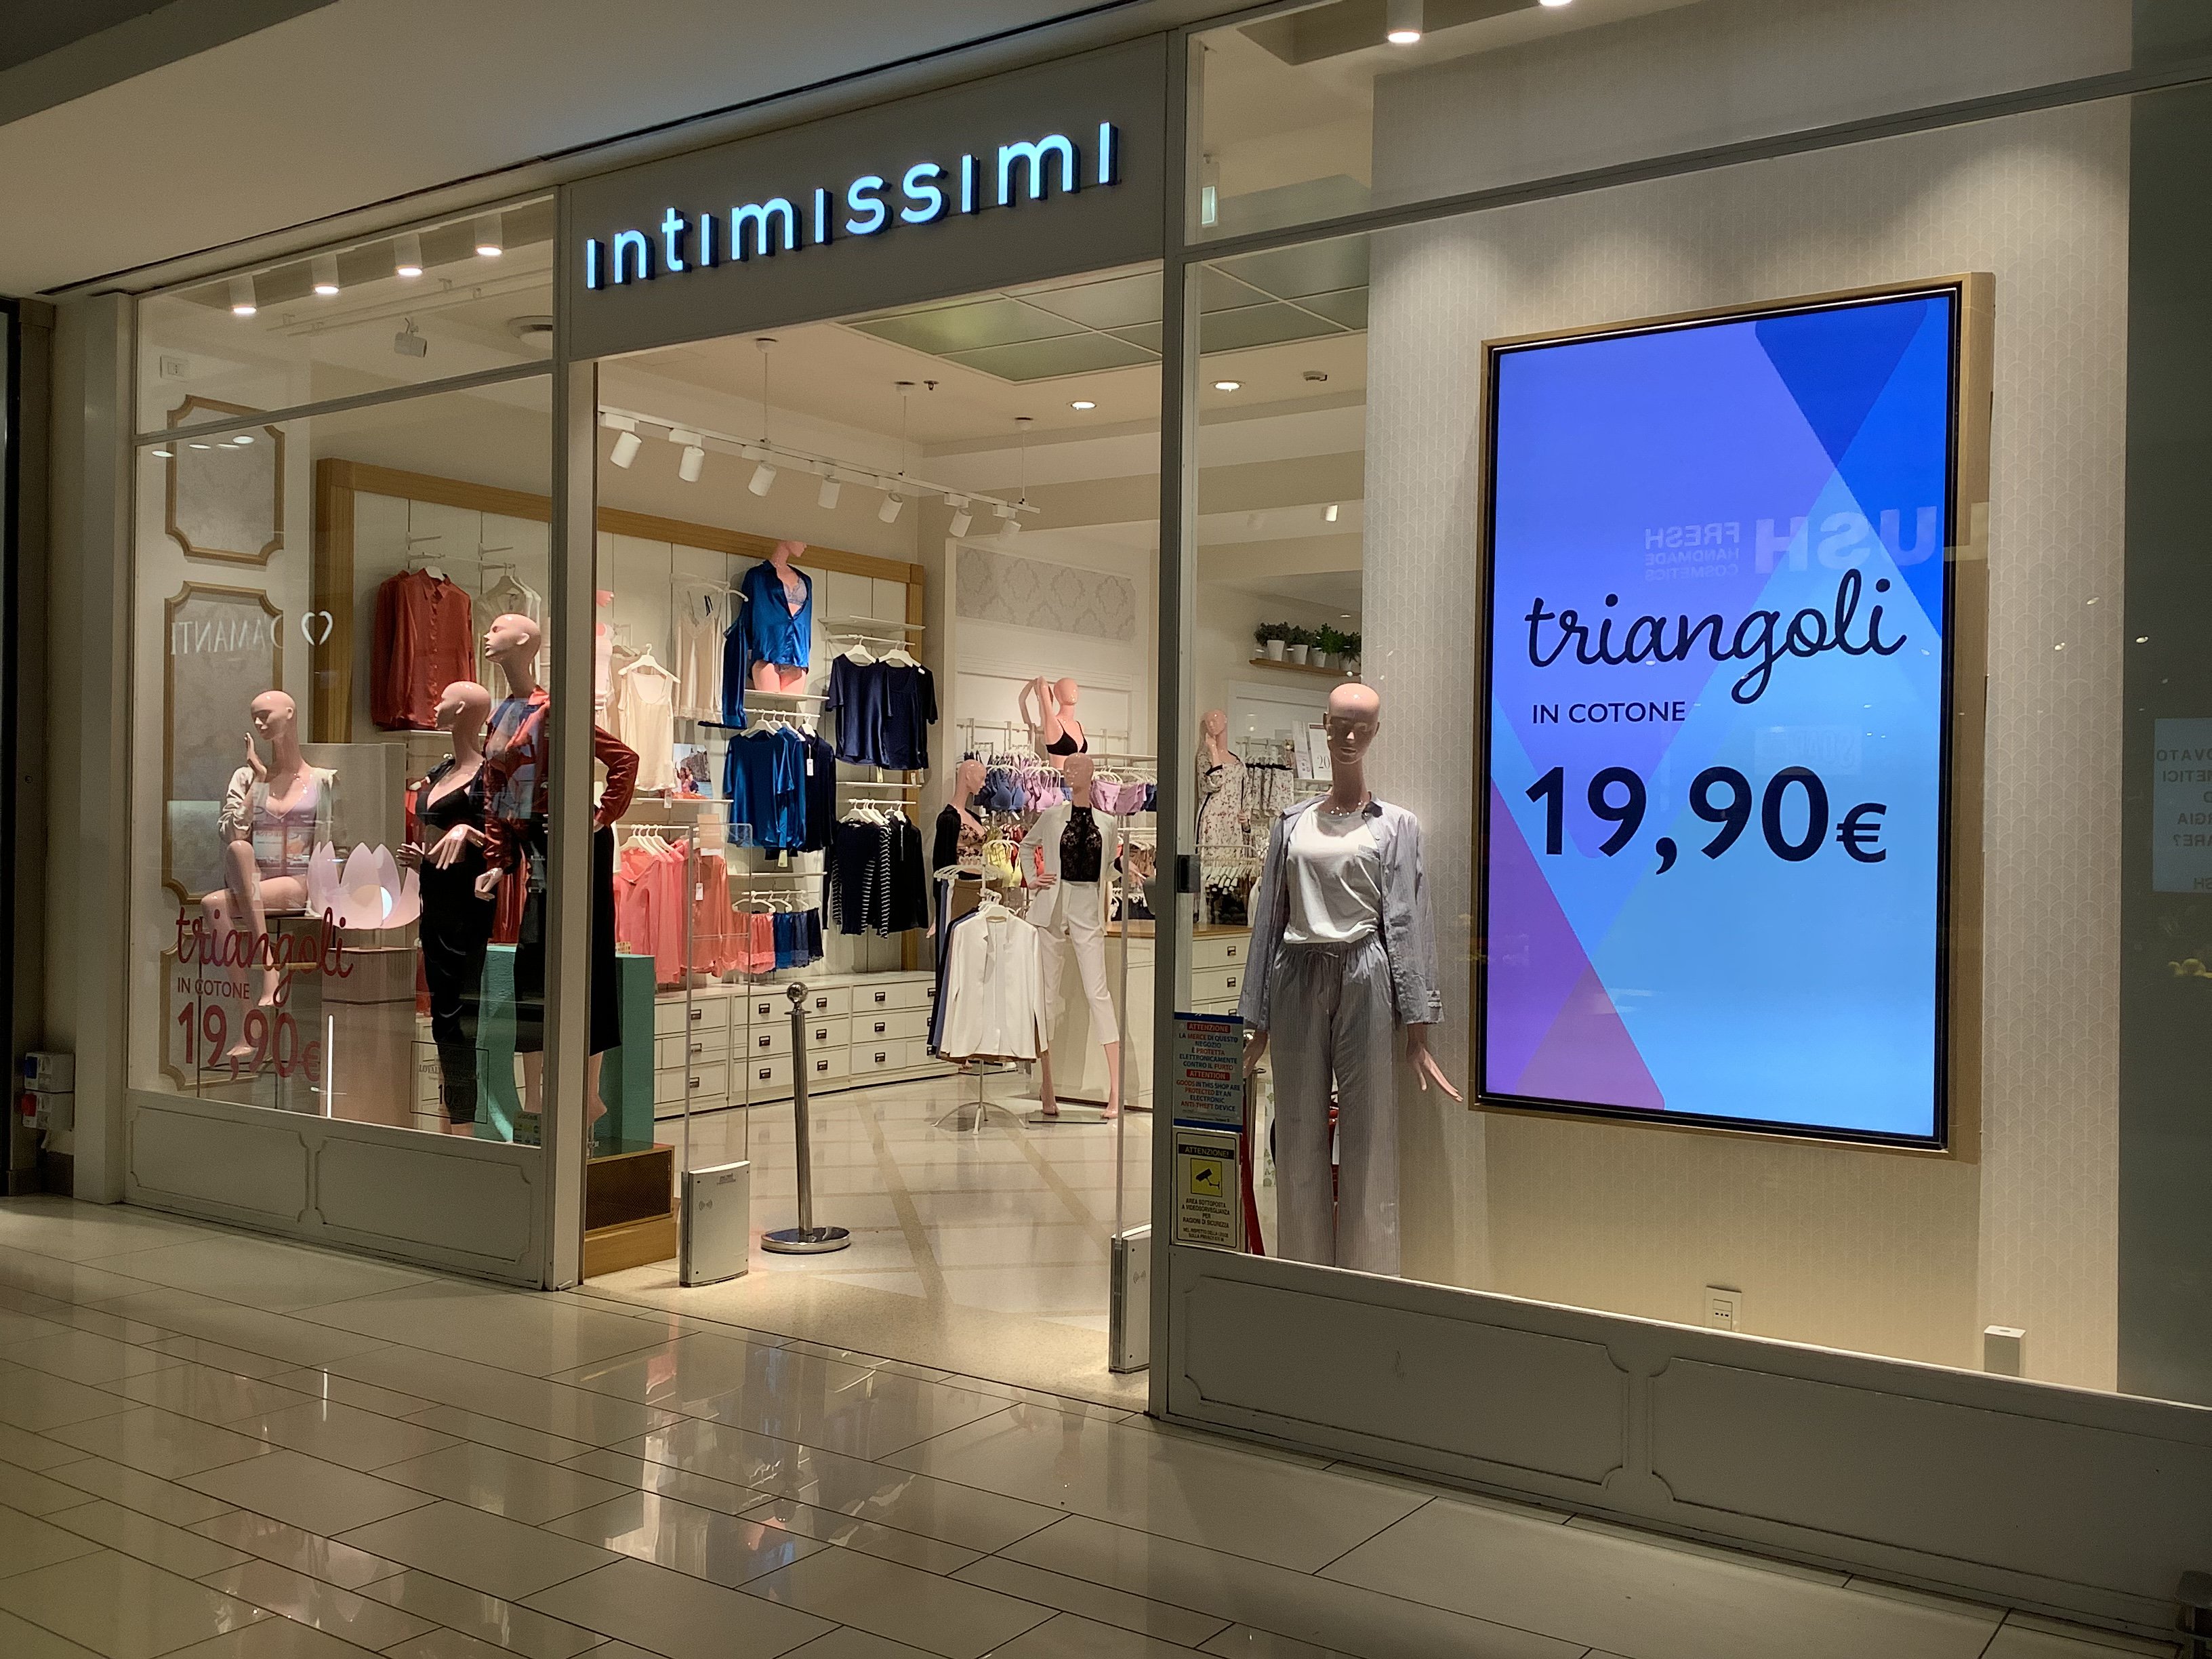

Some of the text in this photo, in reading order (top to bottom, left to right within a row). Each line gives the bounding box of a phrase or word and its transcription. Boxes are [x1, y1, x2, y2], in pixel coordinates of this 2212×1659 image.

[1524, 569, 1907, 705] triangoli
[1532, 701, 1685, 724] IN COTONE
[1525, 766, 1887, 875] 19,90€
[176, 907, 353, 1008] triangoli
[178, 977, 250, 1000] IN COTONE
[1189, 1023, 1229, 1032] ATTENZIONE
[177, 1002, 321, 1082] 19,90€
[1196, 1048, 1225, 1056] PROTETTA
[1180, 1054, 1237, 1064] ELETTRONICAMENTE
[1190, 1071, 1225, 1079] ATTENTION
[1185, 1087, 1214, 1095] PROTECTED
[1190, 1094, 1225, 1103] ELECTRONIC
[1185, 1146, 1229, 1158] ATTENZIONE!
